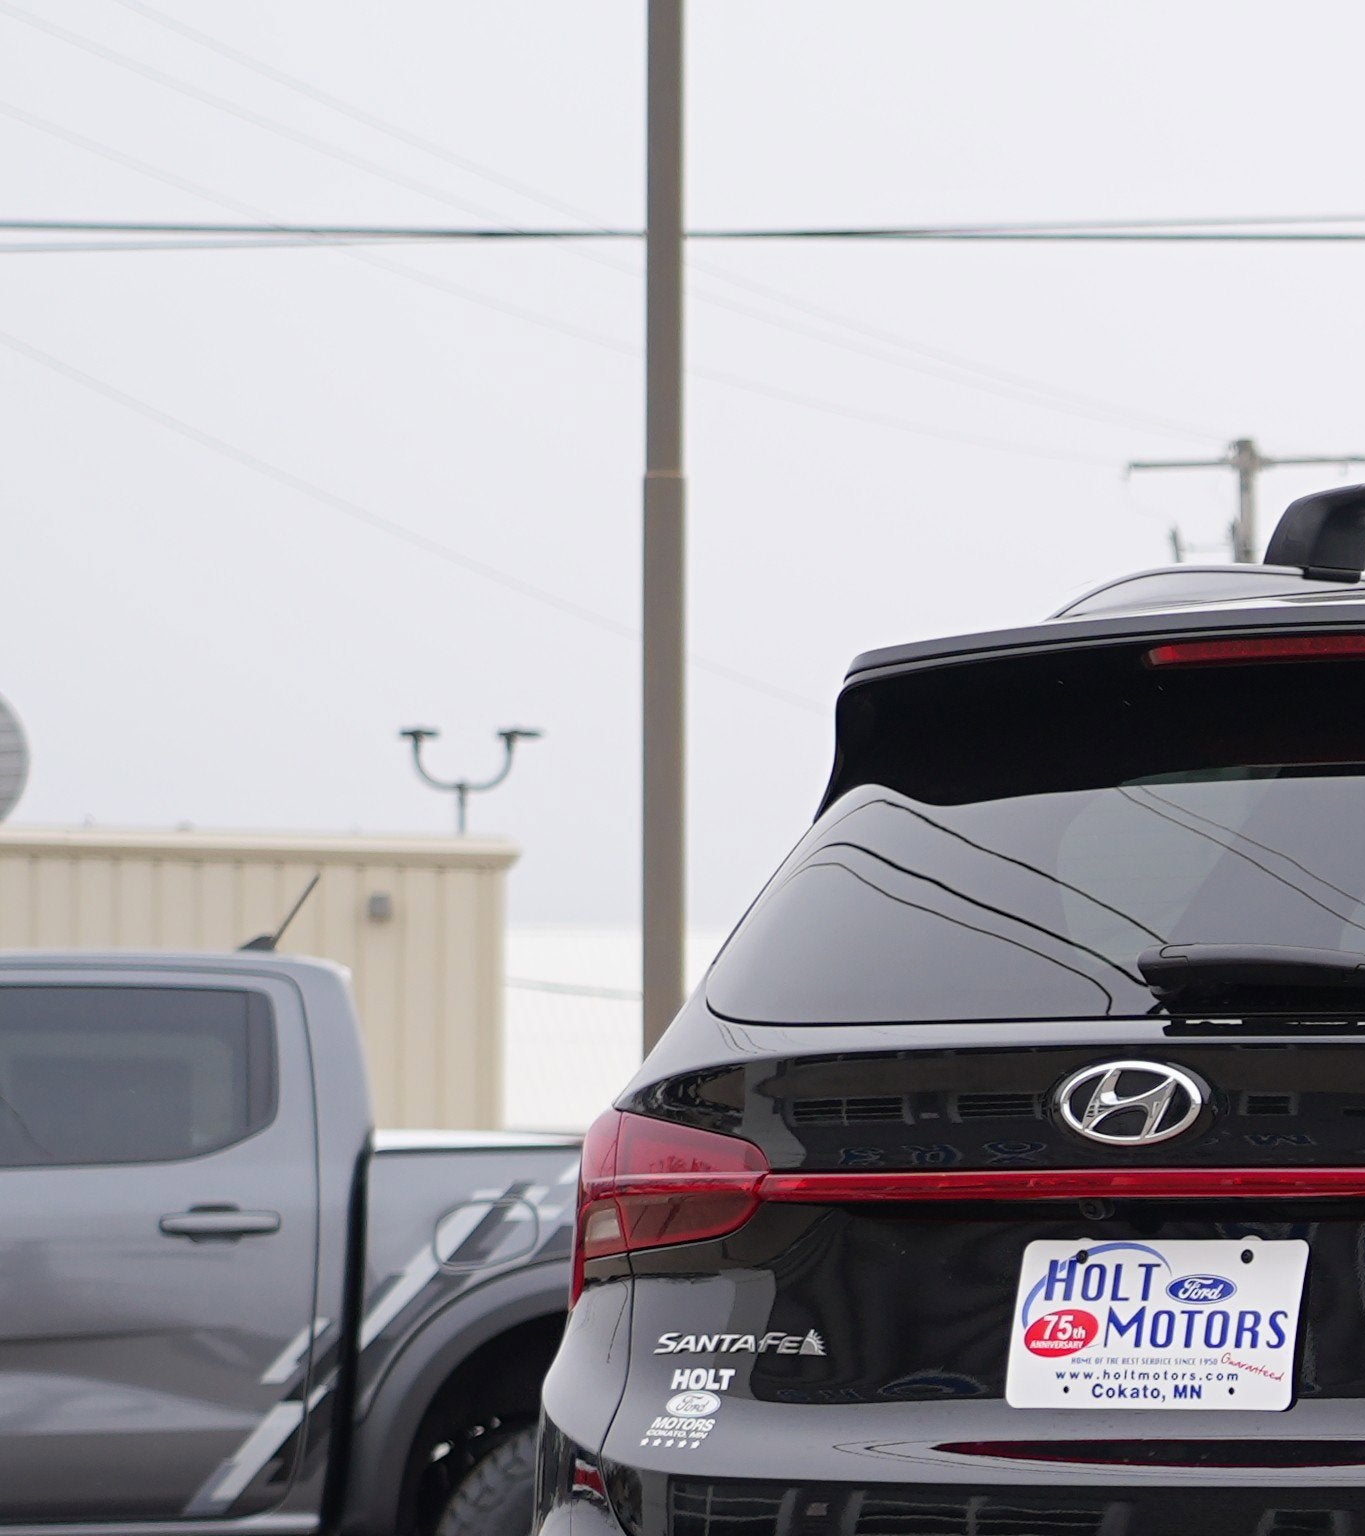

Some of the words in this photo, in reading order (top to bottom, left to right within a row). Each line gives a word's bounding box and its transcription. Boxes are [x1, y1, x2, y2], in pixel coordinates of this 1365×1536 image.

[1044, 1259, 1162, 1301] HOLT
[1178, 1278, 1225, 1301] Ford
[1043, 1314, 1087, 1340] 75th
[1103, 1305, 1289, 1349] MOTORS
[1029, 1340, 1084, 1350] ANNIVERSARY
[1174, 1358, 1196, 1366] SINCE
[1220, 1352, 1286, 1382] Guaranteed
[670, 1368, 735, 1391] HOLT
[1056, 1368, 1239, 1382] www.holtmotors.com
[1091, 1383, 1166, 1402] Cokato,
[1173, 1384, 1202, 1399] MN
[675, 1394, 710, 1413] Ford
[651, 1416, 716, 1432] MOTORS
